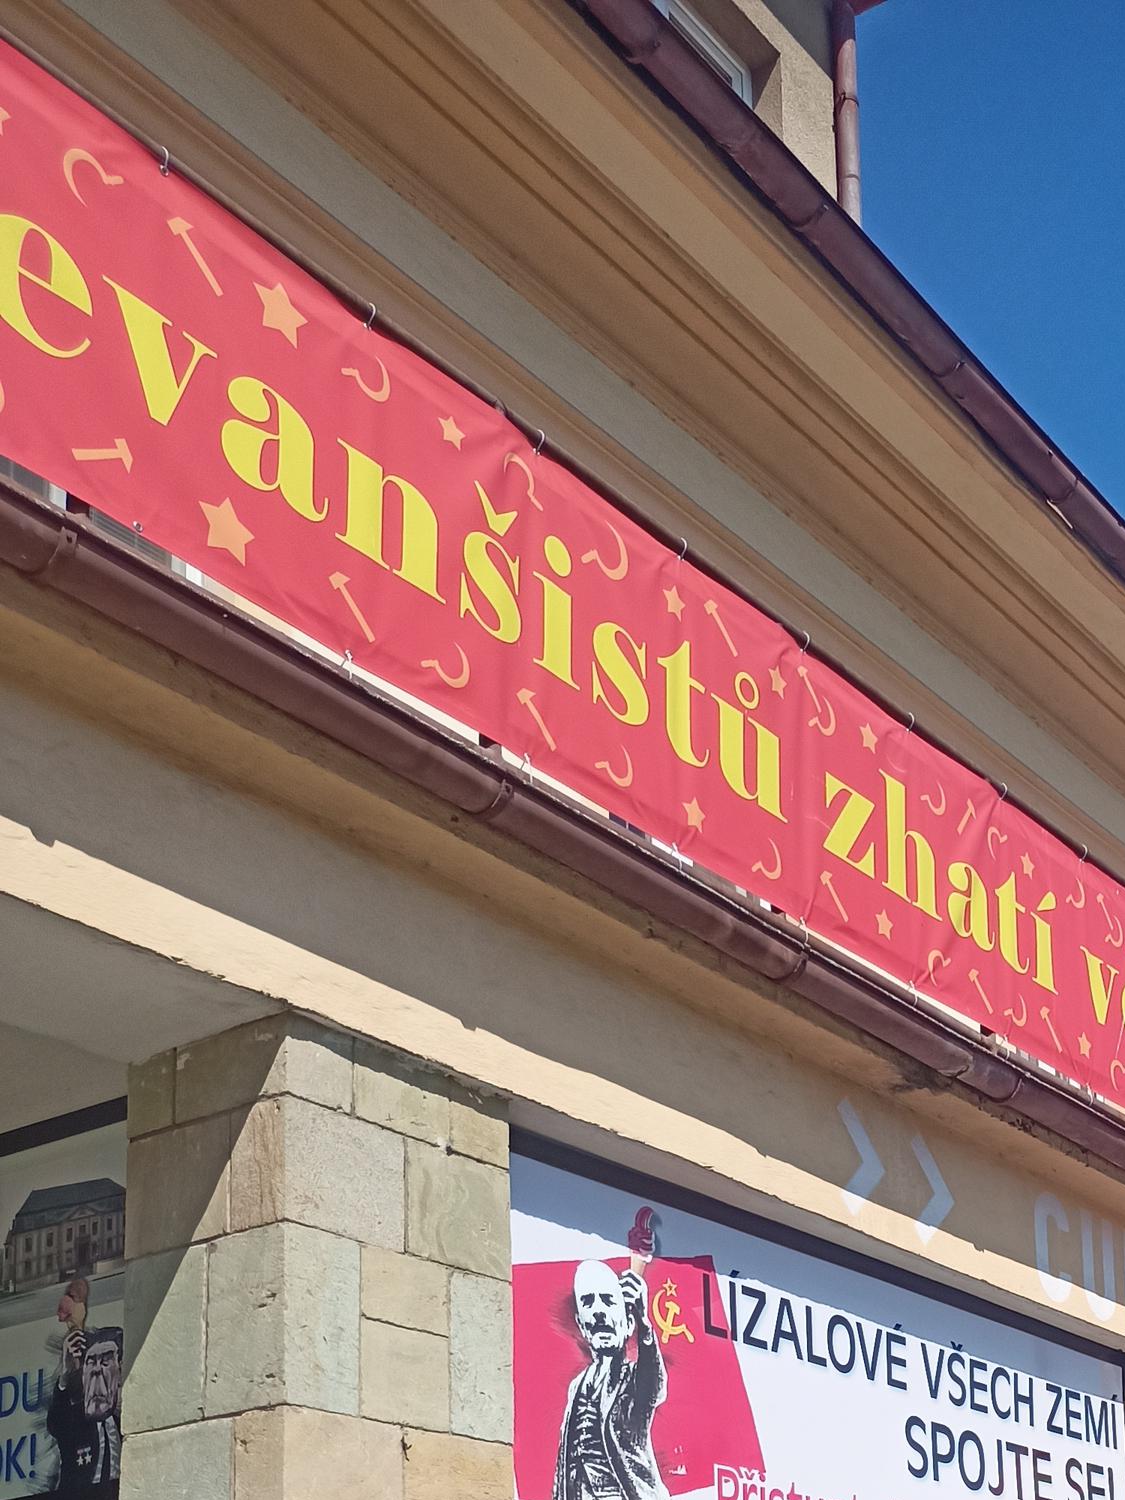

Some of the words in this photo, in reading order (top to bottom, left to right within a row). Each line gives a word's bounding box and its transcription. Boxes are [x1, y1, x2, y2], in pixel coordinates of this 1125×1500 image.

[822, 768, 1059, 996] zhatí
[702, 1269, 908, 1391] LÍZALOVÉ
[920, 1340, 1035, 1427] VŠECH
[1045, 1382, 1118, 1450] ZEMÍ
